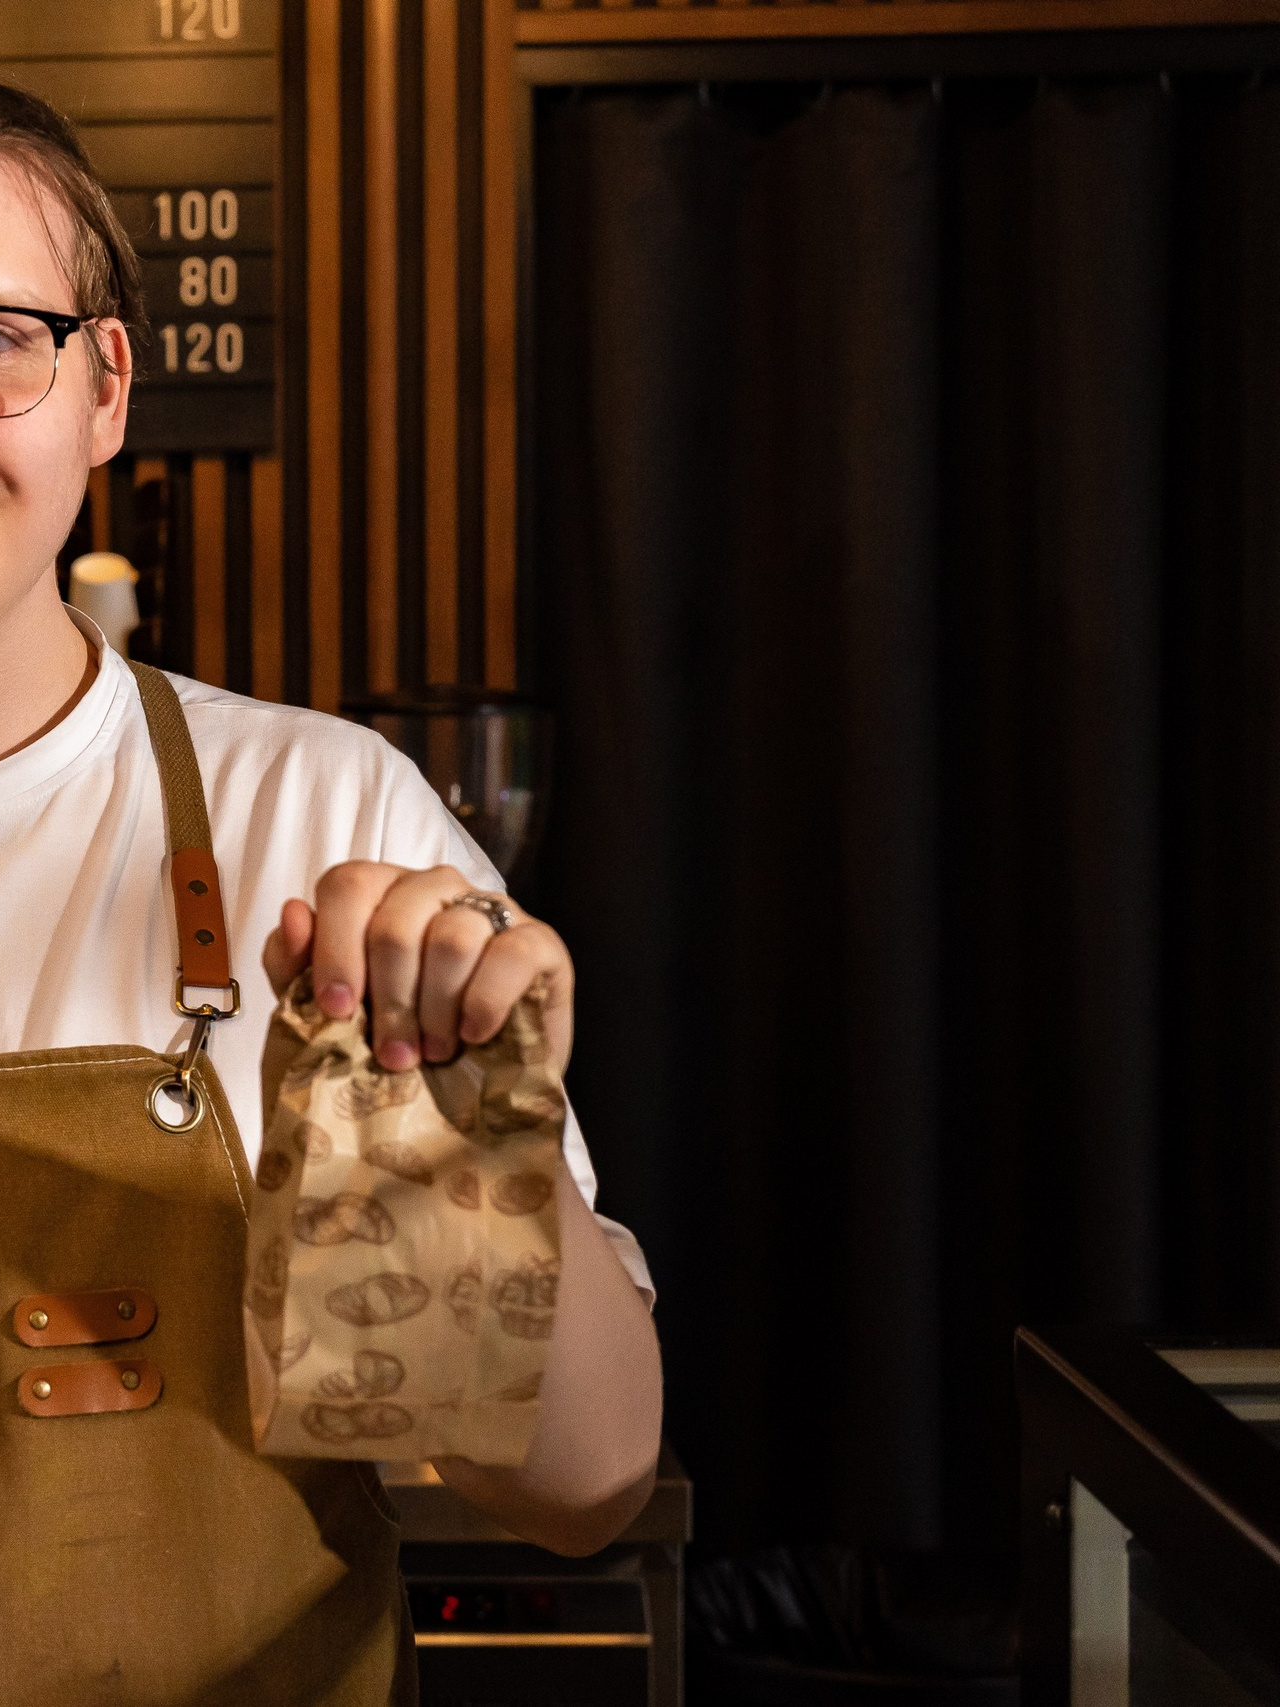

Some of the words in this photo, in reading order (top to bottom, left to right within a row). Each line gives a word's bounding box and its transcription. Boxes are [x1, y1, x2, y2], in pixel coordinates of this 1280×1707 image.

[158, 0, 241, 41] 120
[155, 190, 238, 240] 100
[179, 256, 238, 305] 80
[161, 323, 245, 373] 120
